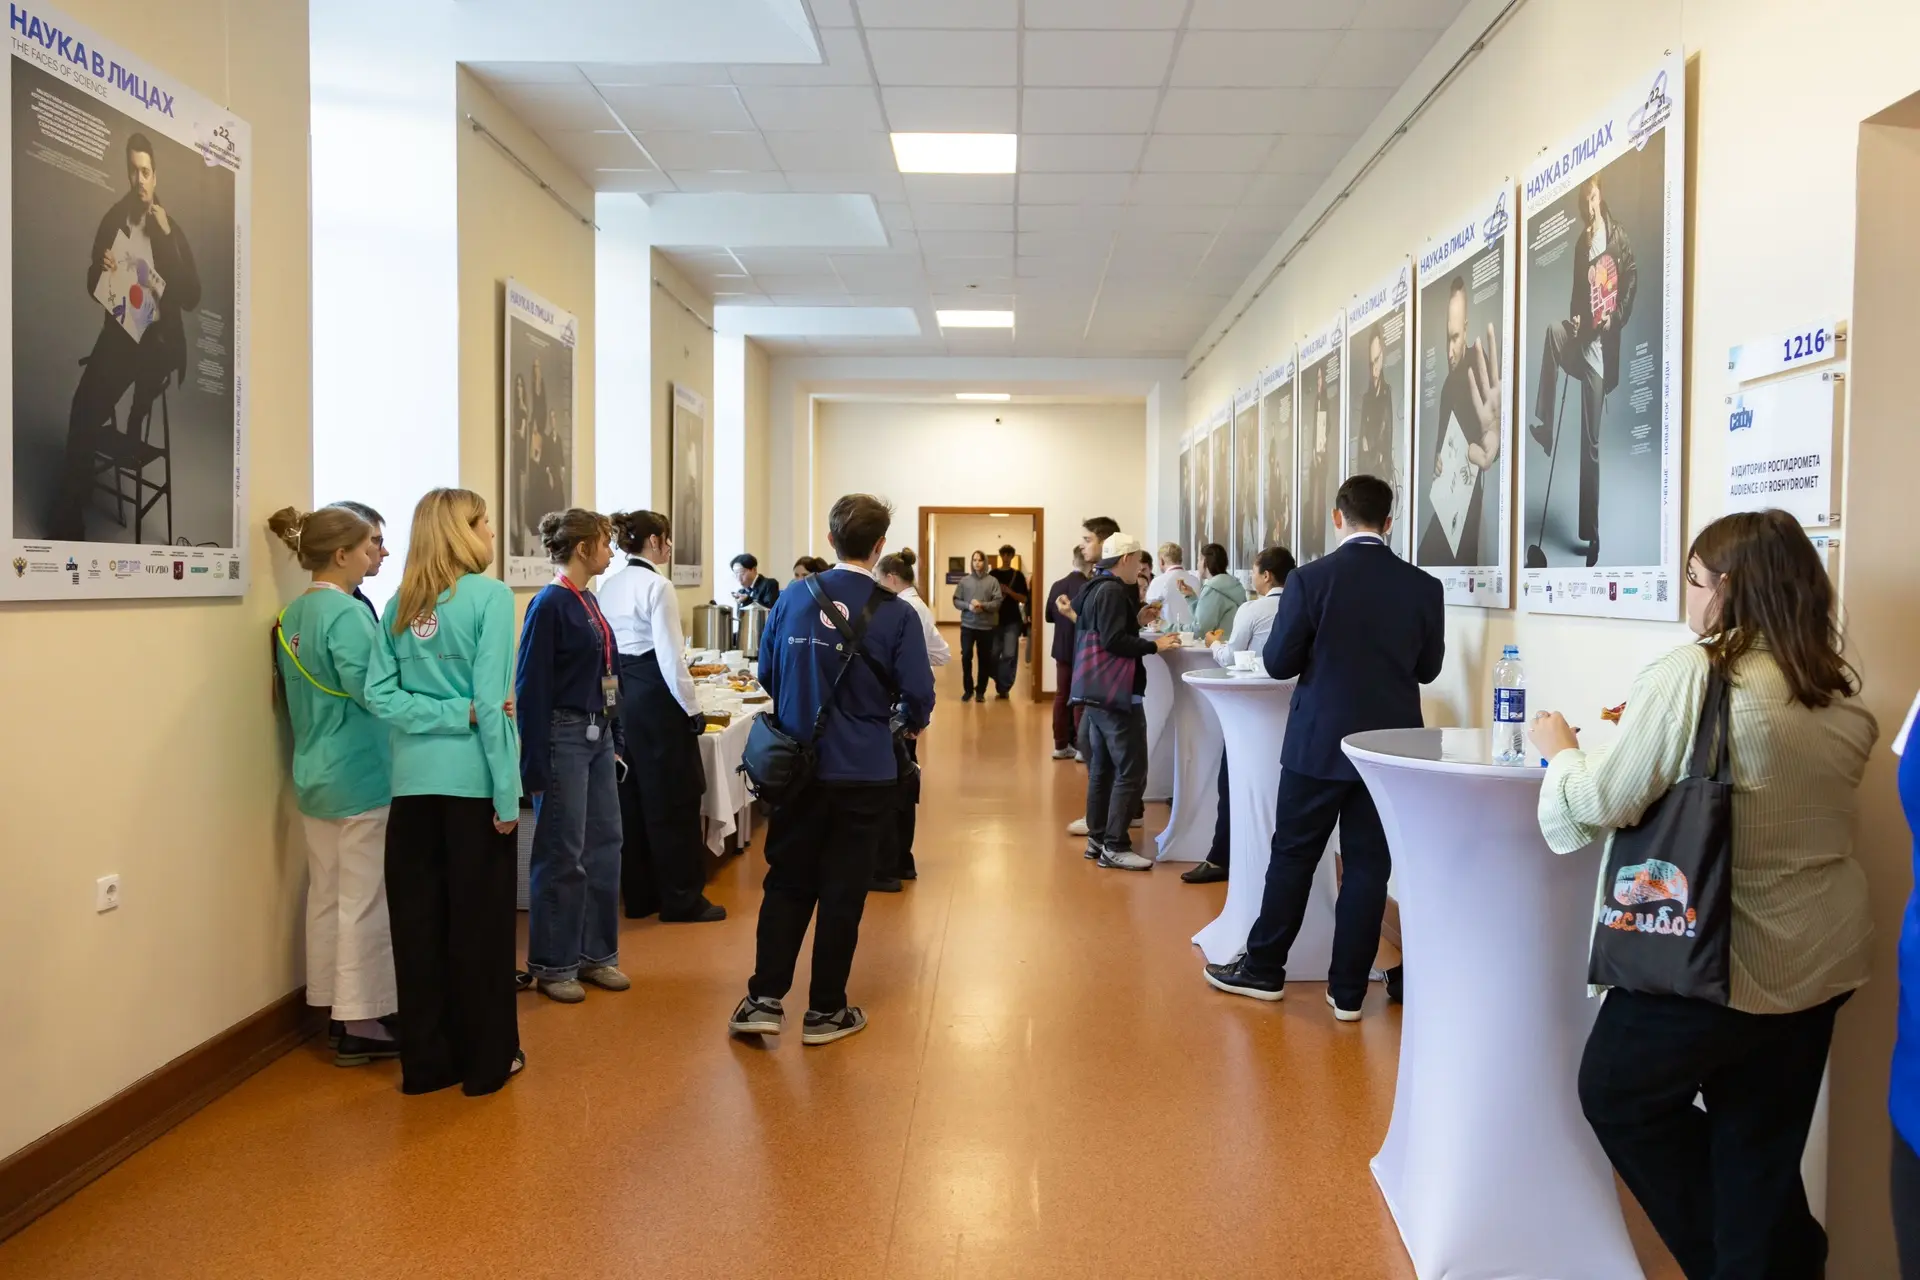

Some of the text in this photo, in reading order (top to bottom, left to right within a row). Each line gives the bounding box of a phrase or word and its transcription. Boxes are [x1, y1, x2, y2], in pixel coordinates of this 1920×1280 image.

[10, 2, 174, 118] НАУКА В ЛИЦАХ
[11, 36, 108, 98] THE FACES OF SCIENCE
[1526, 160, 1561, 201] НАУКА
[1562, 153, 1570, 177] В
[1570, 119, 1613, 170] ЛИЦАХ
[1420, 246, 1444, 275] НАУКА
[1450, 222, 1475, 256] ЛИЦАХ
[1783, 328, 1825, 362] 1216
[1730, 475, 1819, 496] AUDIENCE OF ROSHYDROMET
[1731, 454, 1820, 478] АУДИТОРИЯ РОСГИДРОМЕТА
